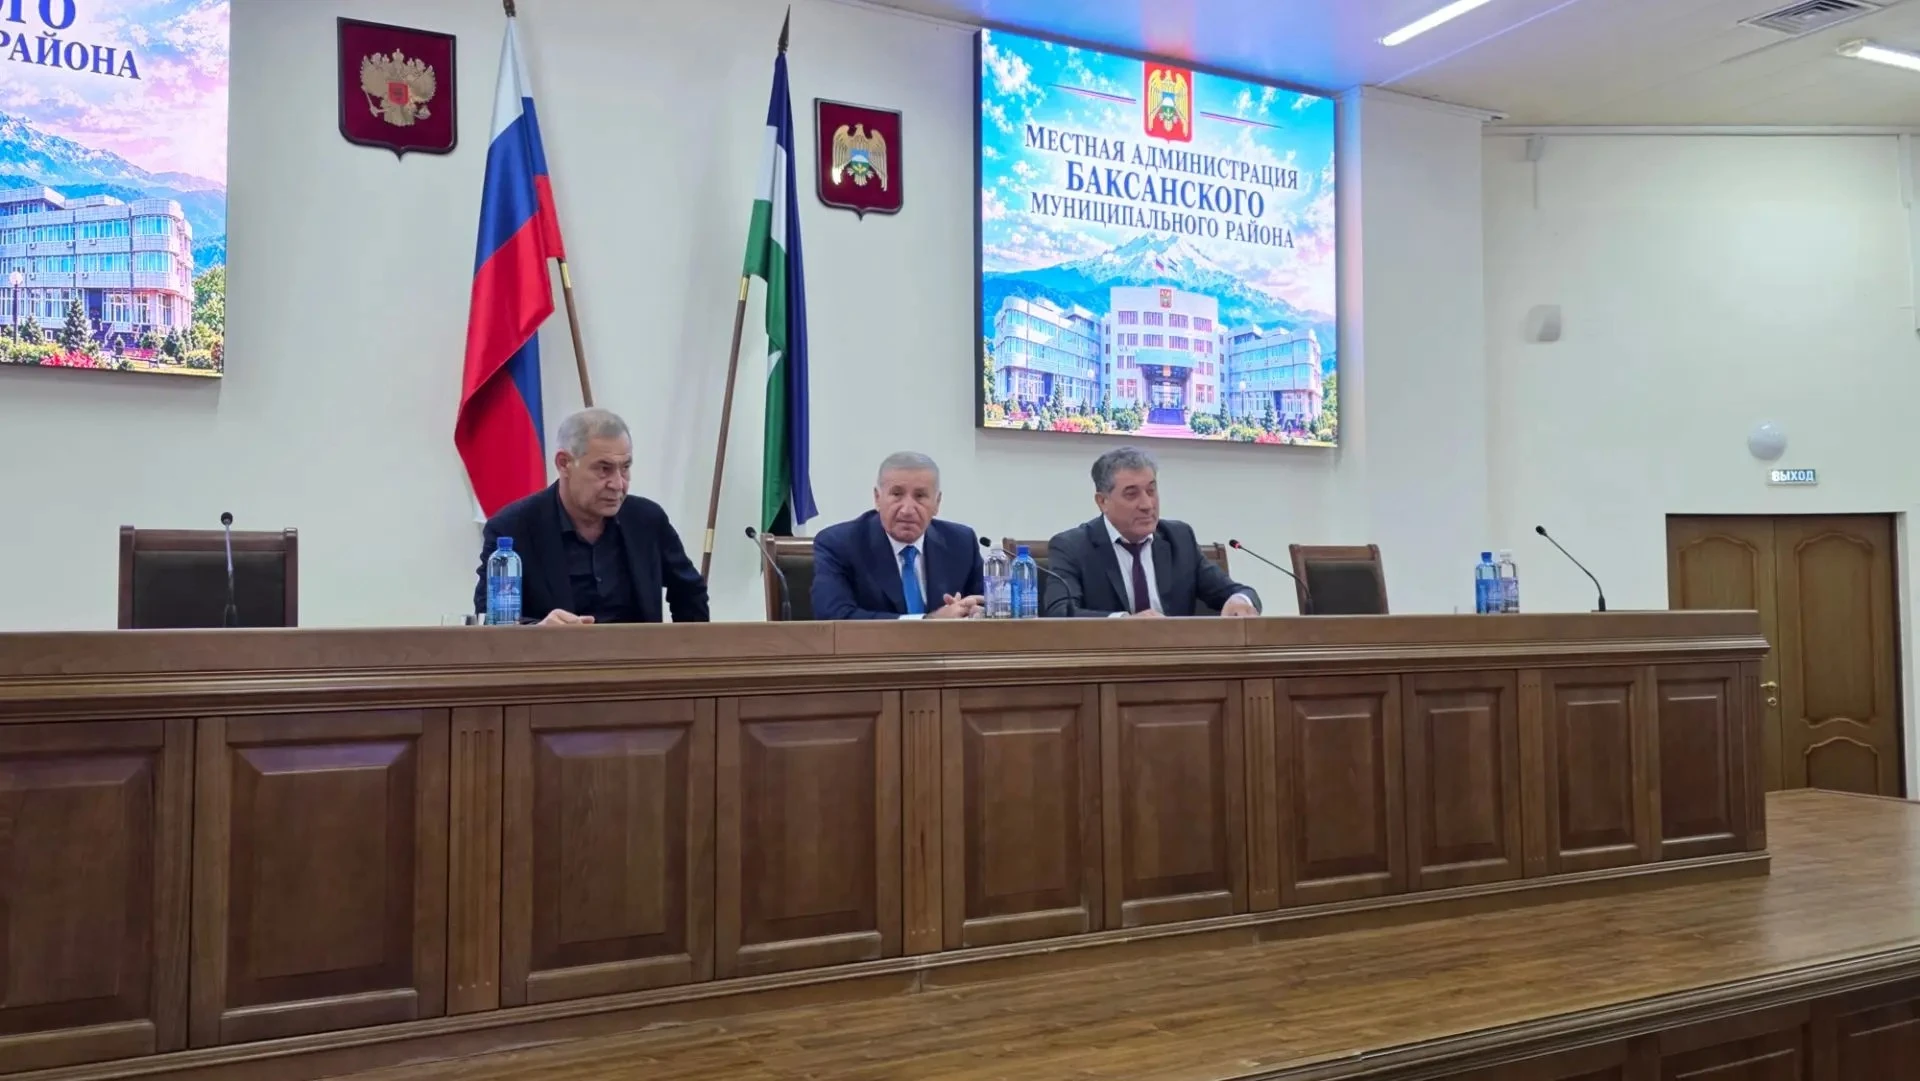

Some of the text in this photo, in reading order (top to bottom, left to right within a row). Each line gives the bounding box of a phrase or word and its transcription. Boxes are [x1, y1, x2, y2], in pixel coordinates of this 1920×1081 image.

[1025, 123, 1298, 191] МЕСТНАЯ АДМИНИСТРАЦИЯ
[1065, 159, 1265, 218] БАКСАНСКОГО
[1030, 191, 1295, 249] МУНИЦИПАЛЬНОГО РАЙОНА
[1771, 469, 1814, 482] ВЫХОД
